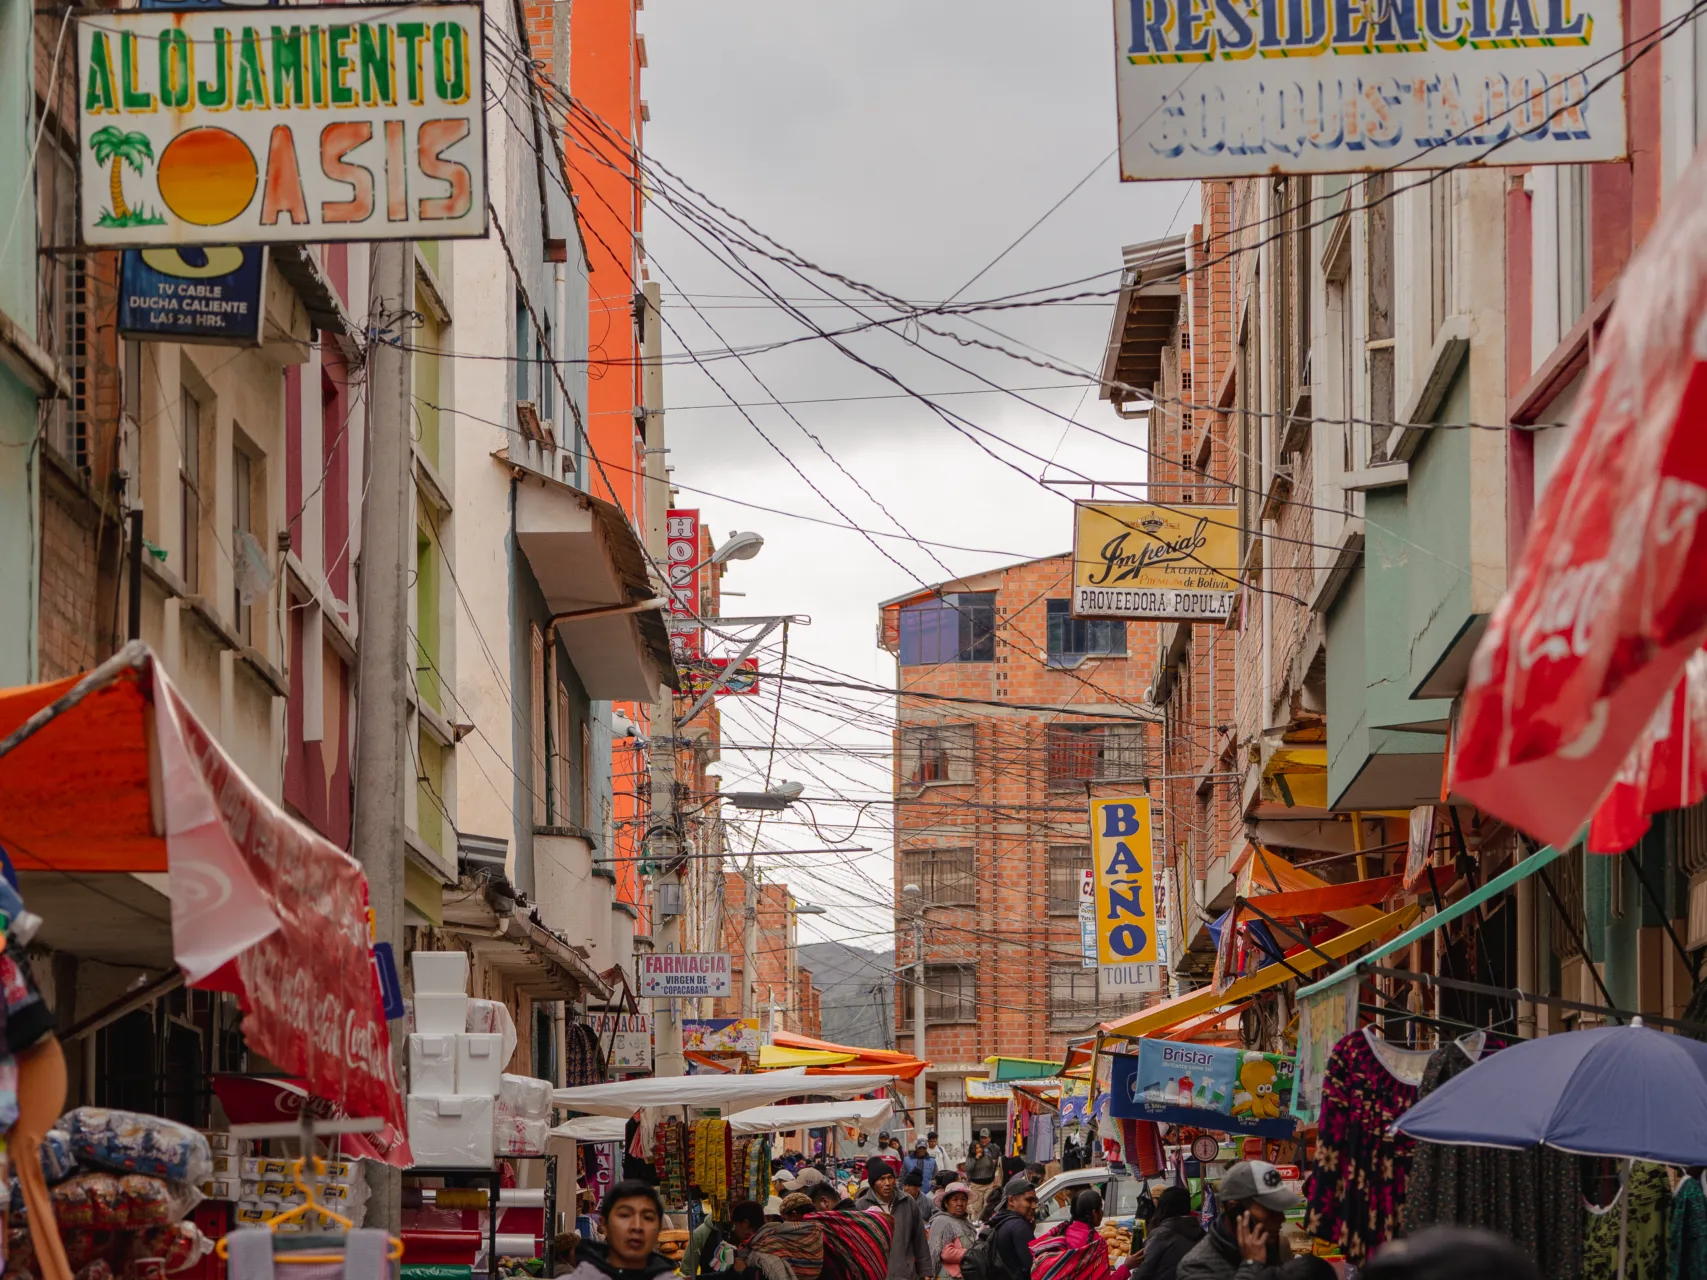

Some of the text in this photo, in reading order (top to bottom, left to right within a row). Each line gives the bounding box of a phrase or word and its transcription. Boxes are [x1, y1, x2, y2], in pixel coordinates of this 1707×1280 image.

[1127, 0, 1595, 65] RESIDENCIAL
[86, 20, 471, 115] ALOJAMIENTO
[158, 283, 223, 298] TV CABLE
[129, 296, 249, 314] DUCHA CALIENTE
[150, 311, 226, 328] LAS 24 HRS.
[1088, 517, 1209, 585] Imperial
[1080, 590, 1167, 612] PROVEEDORA
[1101, 803, 1147, 957] BAÑO
[645, 955, 727, 974] FARMACIA
[665, 975, 707, 985] VIRGEN DE
[1103, 963, 1156, 986] TOILET
[590, 1015, 647, 1033] FARMACIA
[1163, 1047, 1214, 1066] Bristar
